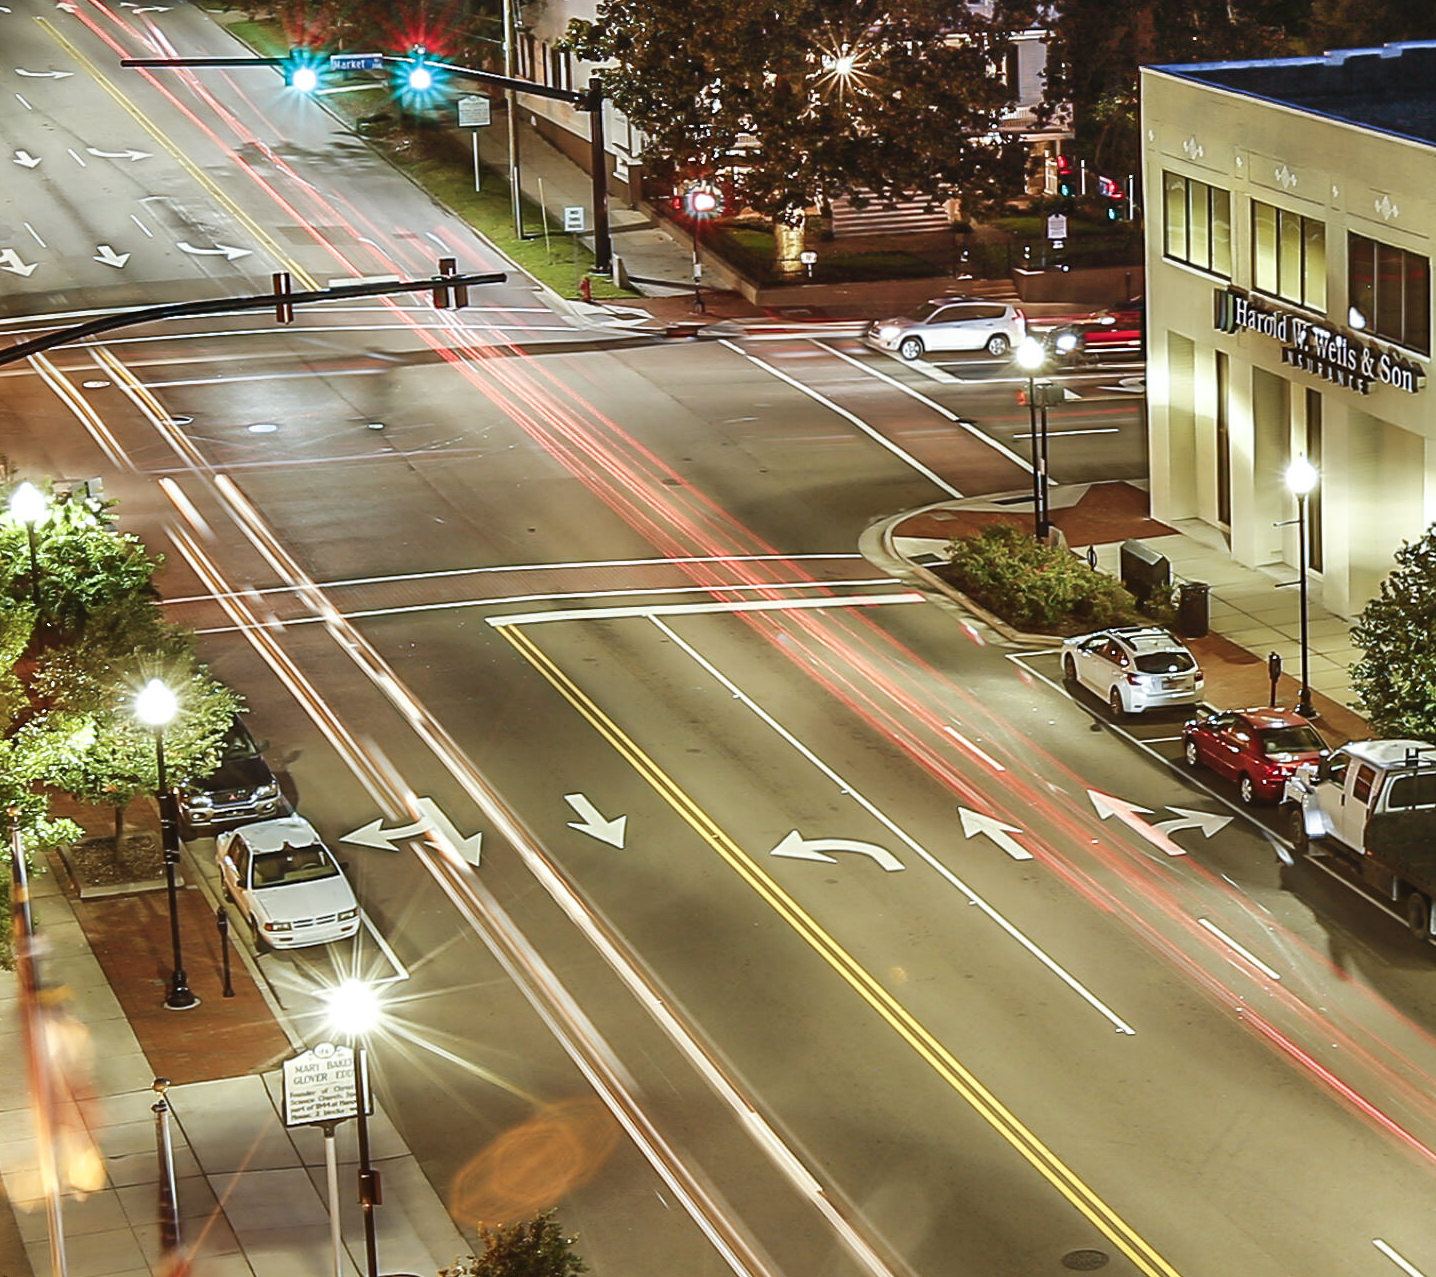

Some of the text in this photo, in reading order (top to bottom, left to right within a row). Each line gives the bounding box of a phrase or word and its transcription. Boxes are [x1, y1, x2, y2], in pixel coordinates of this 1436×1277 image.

[332, 59, 365, 70] Market
[1235, 297, 1414, 393] Harold W. Wells & Son
[327, 1058, 353, 1069] BAKE
[293, 1073, 328, 1084] GLOVER
